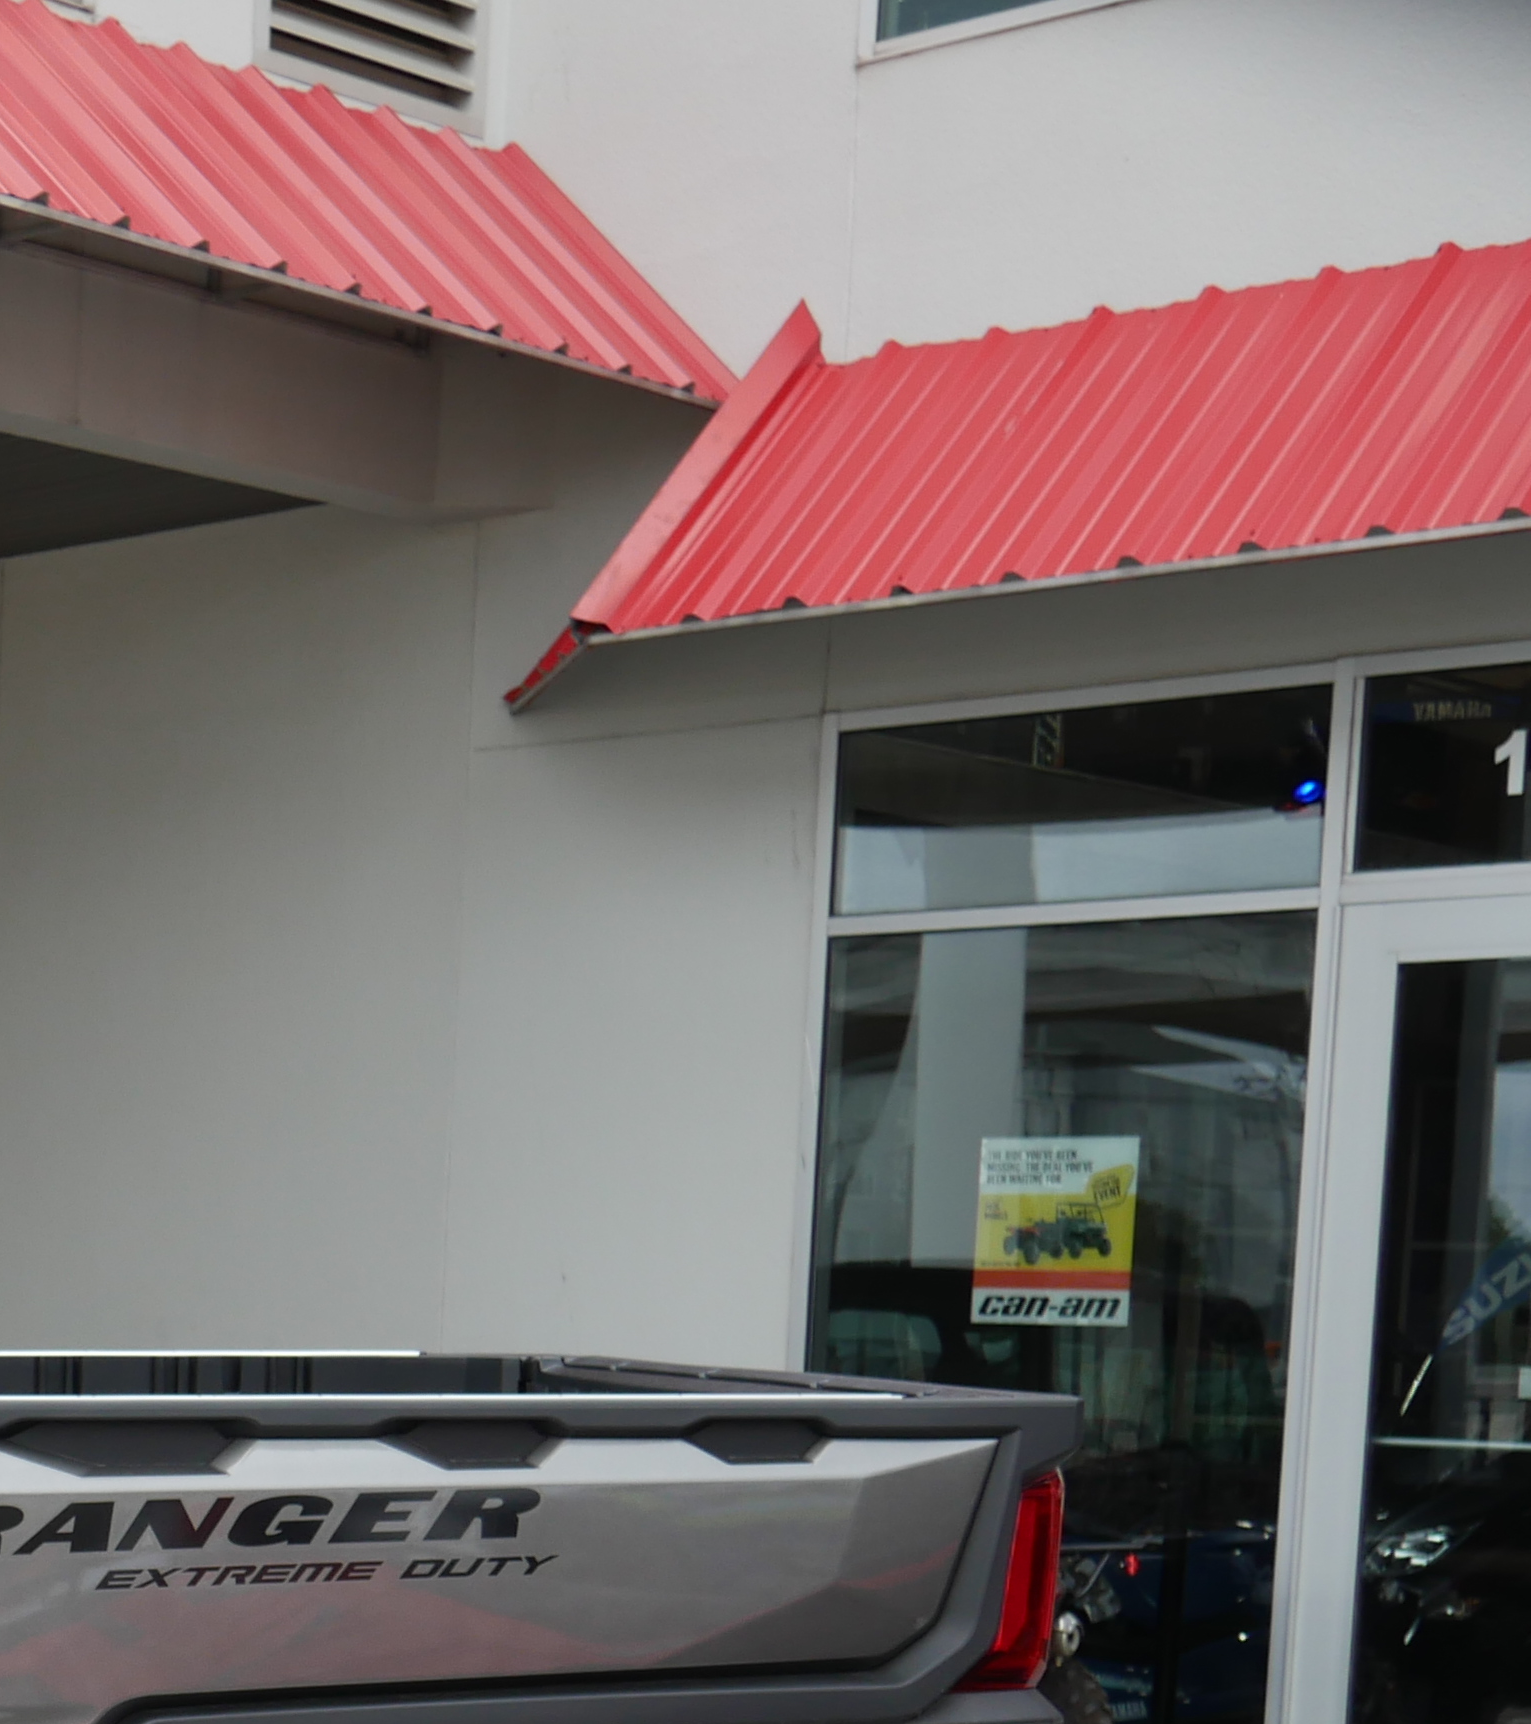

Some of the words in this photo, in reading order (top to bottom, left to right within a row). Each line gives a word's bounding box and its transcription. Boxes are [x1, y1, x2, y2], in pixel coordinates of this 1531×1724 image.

[1413, 698, 1492, 722] YAMAHA
[978, 1294, 1121, 1320] can-am
[1447, 1254, 1531, 1345] SUZ
[94, 1560, 384, 1591] EXTREME
[399, 1555, 562, 1580] DUTY
